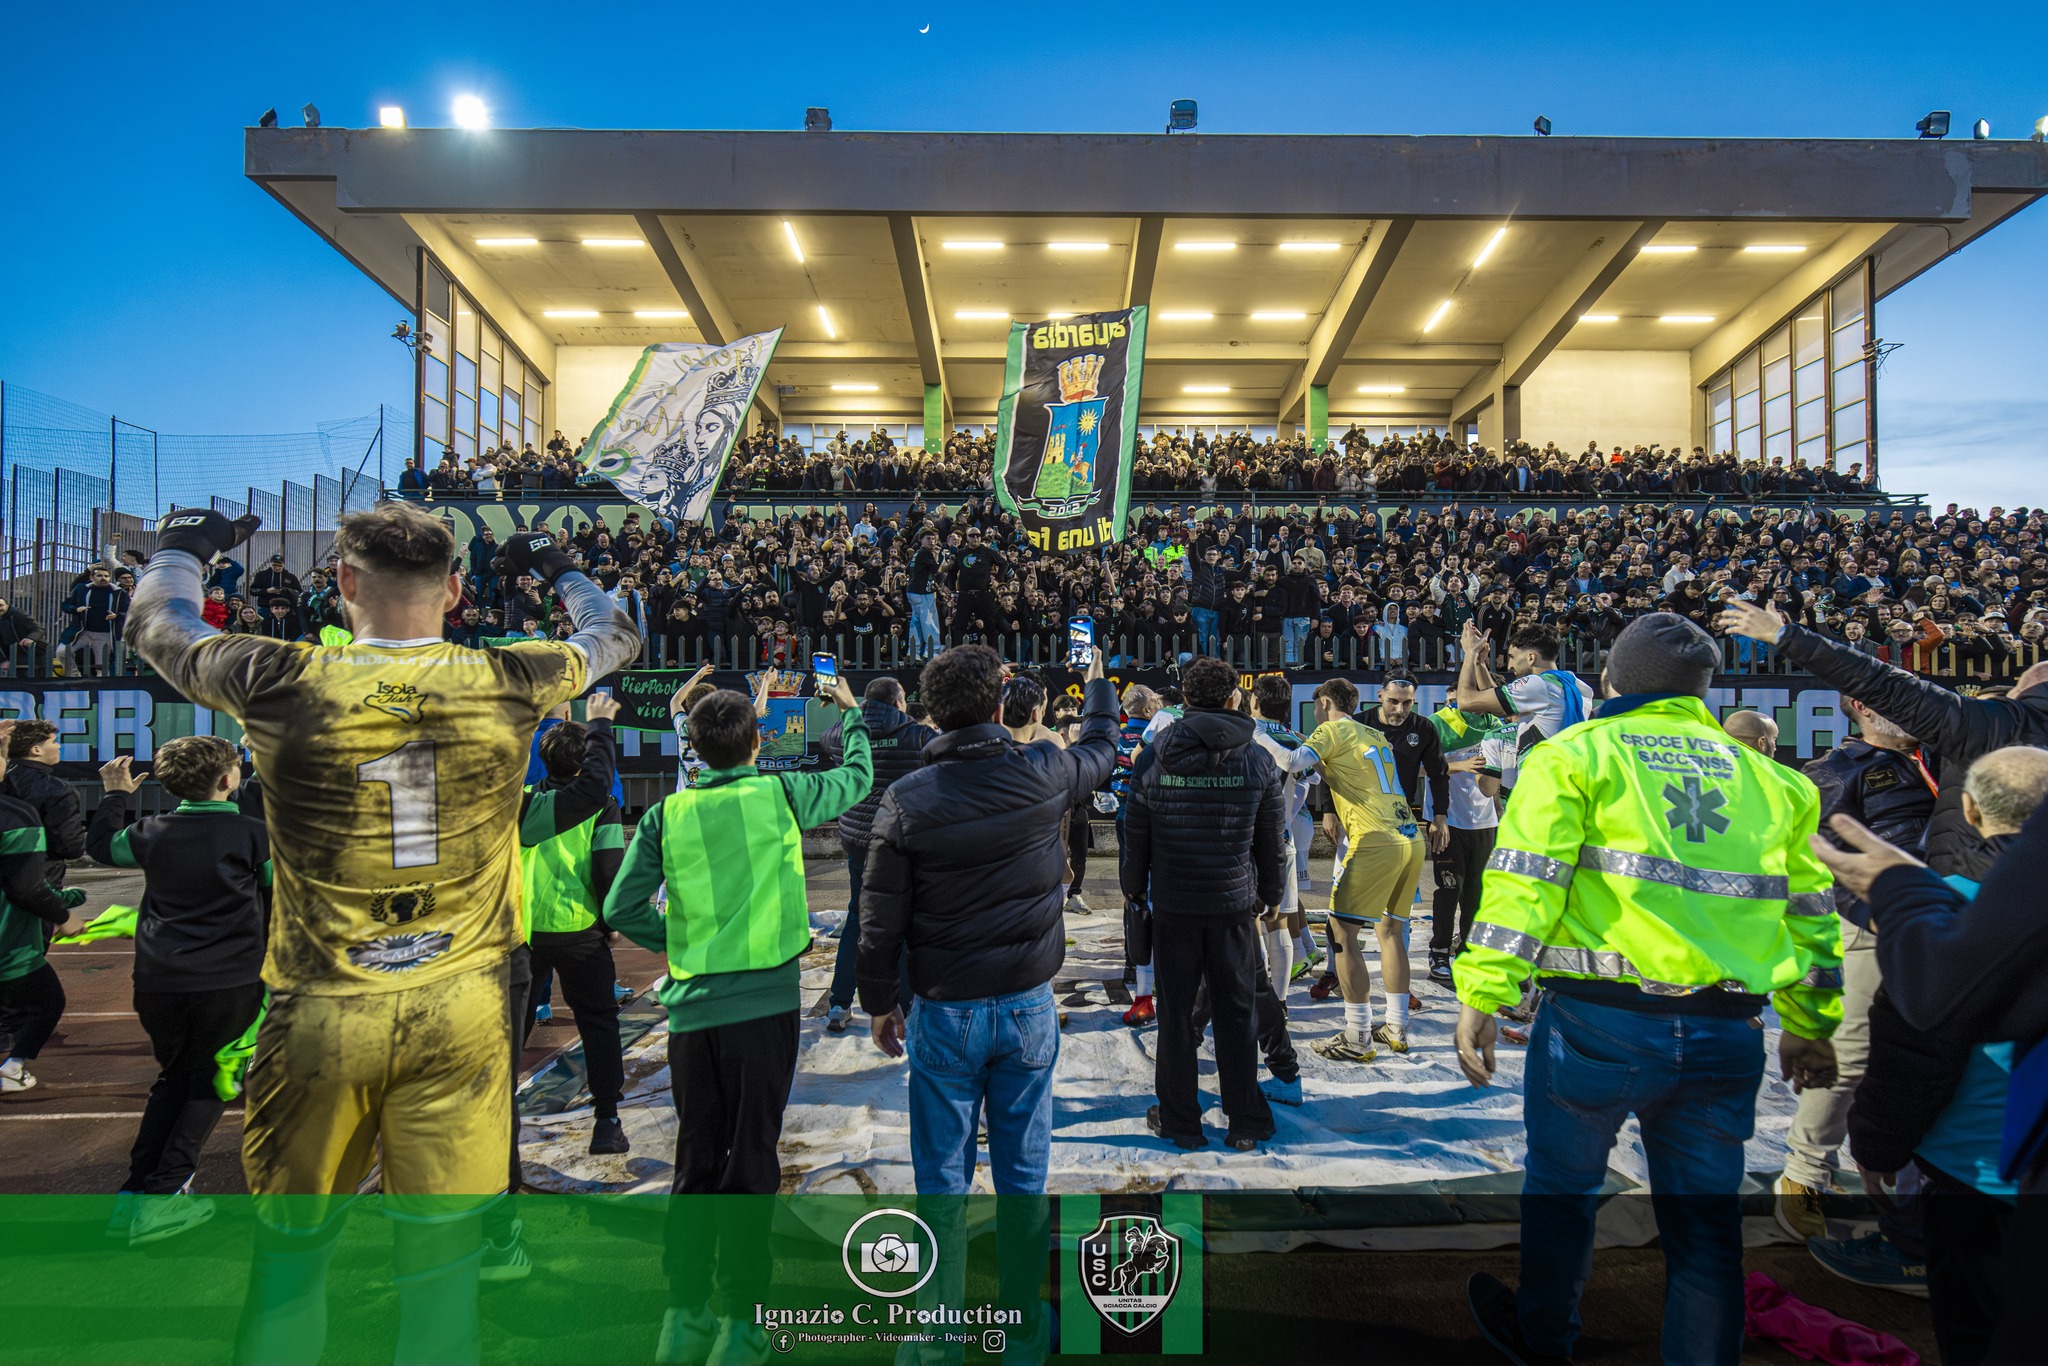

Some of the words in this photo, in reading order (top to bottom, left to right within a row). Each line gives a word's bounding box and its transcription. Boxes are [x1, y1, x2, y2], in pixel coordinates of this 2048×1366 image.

[377, 681, 417, 694] Isola
[637, 702, 666, 719] vive
[1620, 734, 1684, 749] CROCE
[1685, 737, 1740, 758] VERE
[1160, 774, 1185, 787] UNITAS
[356, 740, 438, 869] 1
